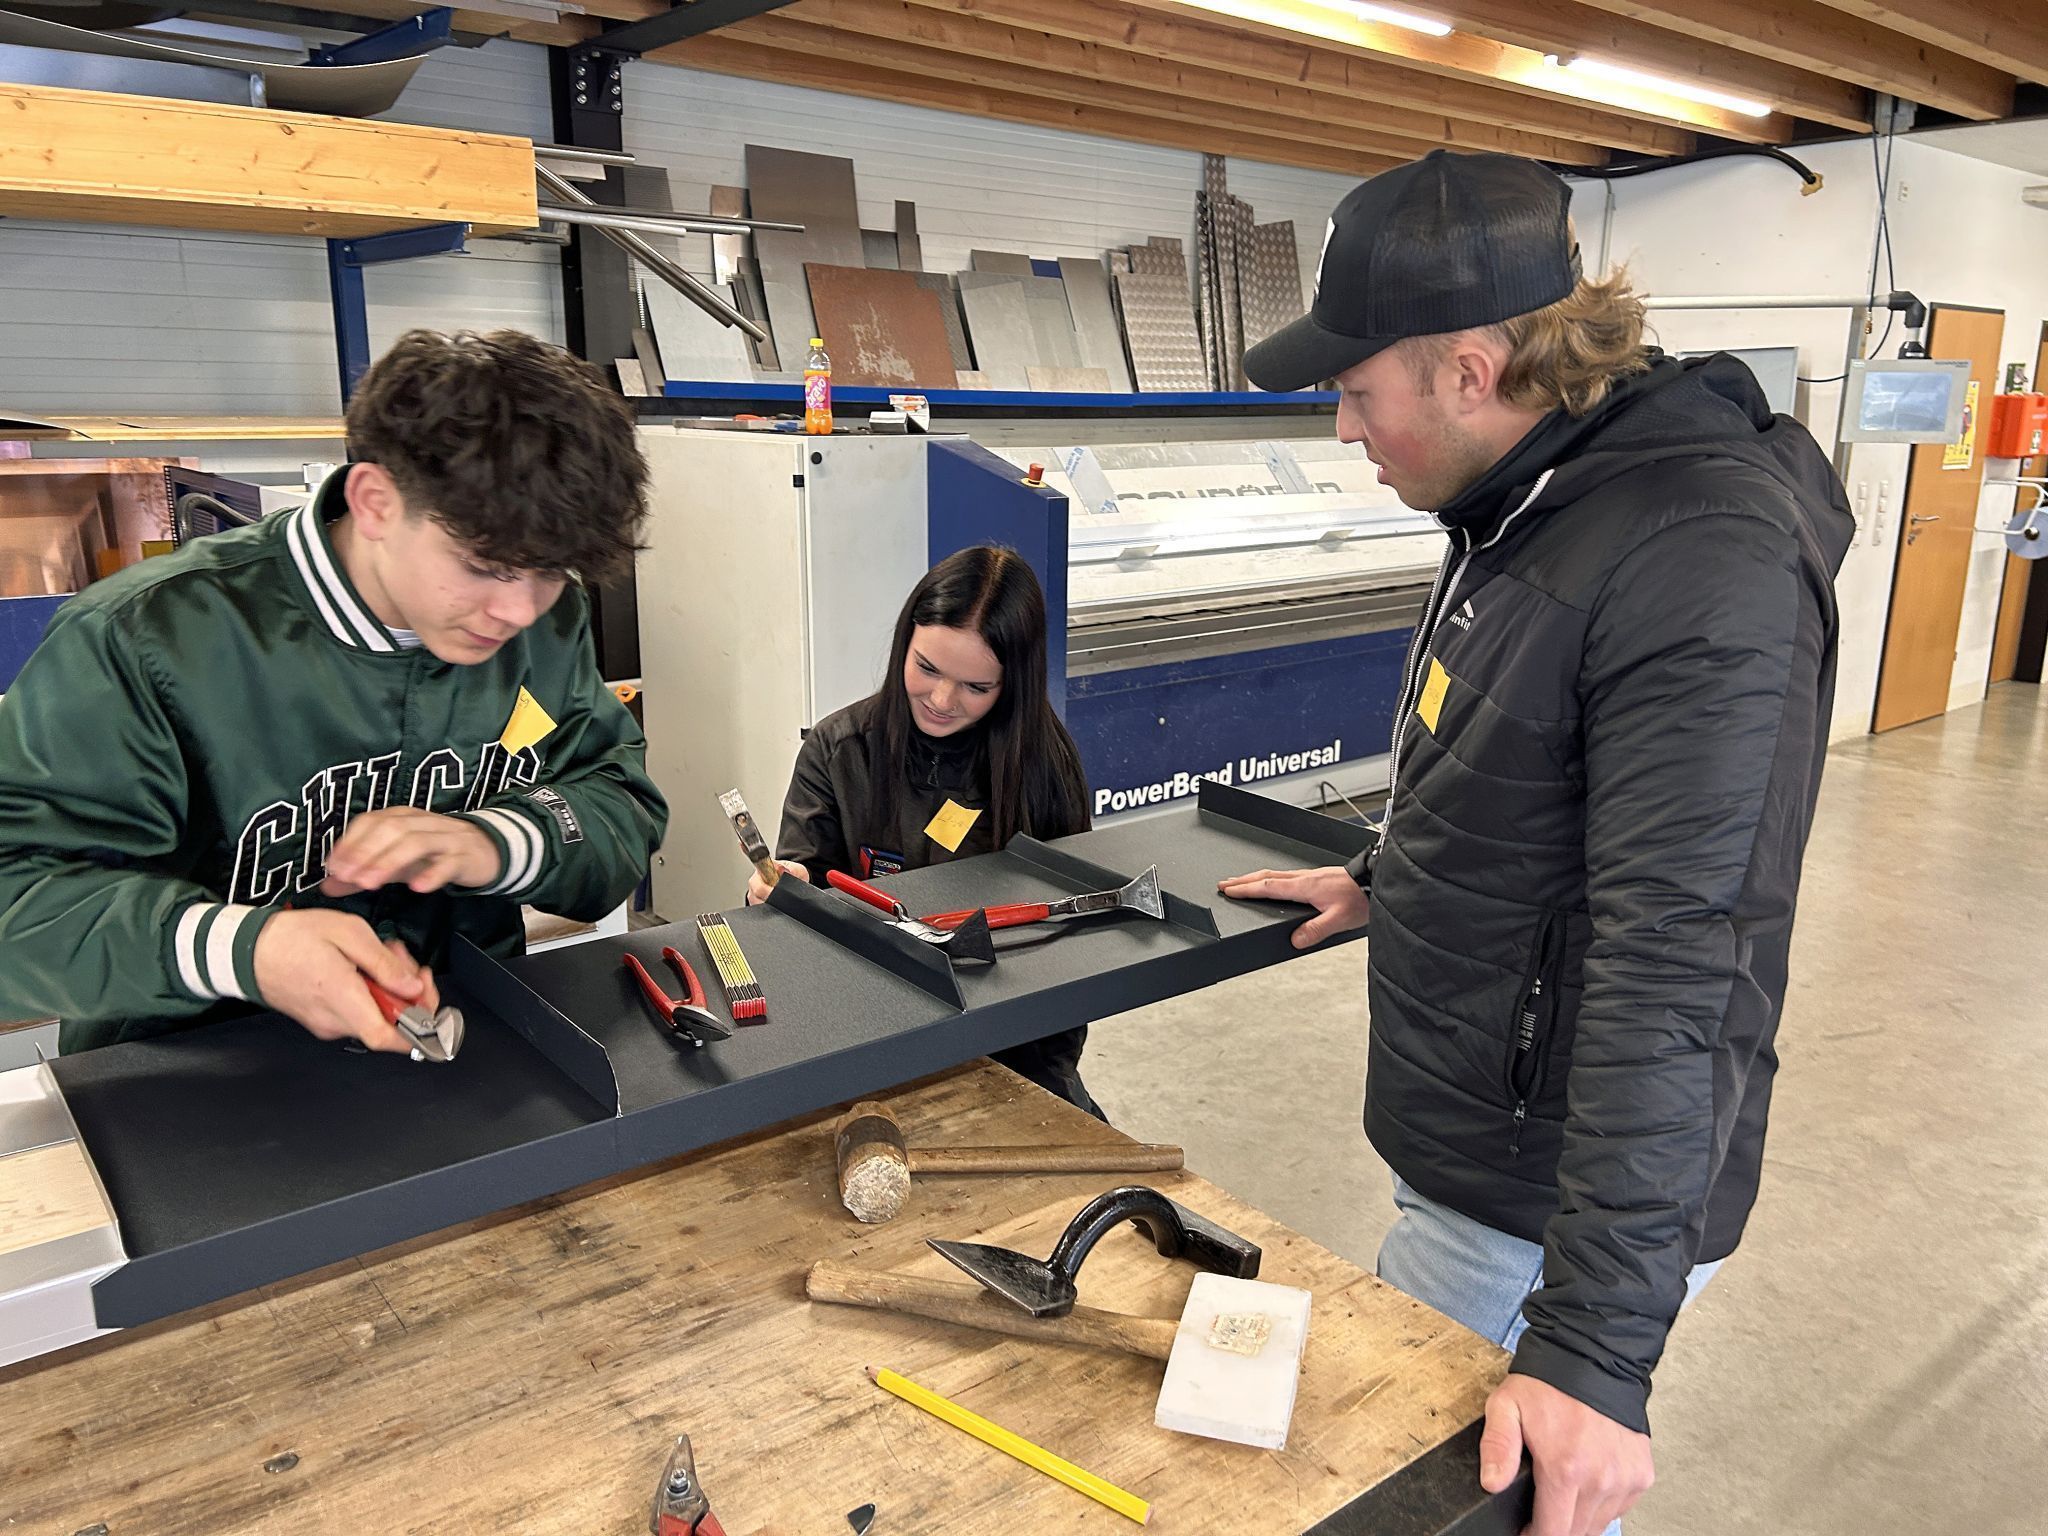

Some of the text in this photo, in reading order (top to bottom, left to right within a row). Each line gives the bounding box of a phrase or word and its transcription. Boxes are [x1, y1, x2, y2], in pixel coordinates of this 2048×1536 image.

[806, 378, 827, 408] bravo
[1449, 612, 1471, 631] infit
[1094, 739, 1342, 815] PowerBend Universal
